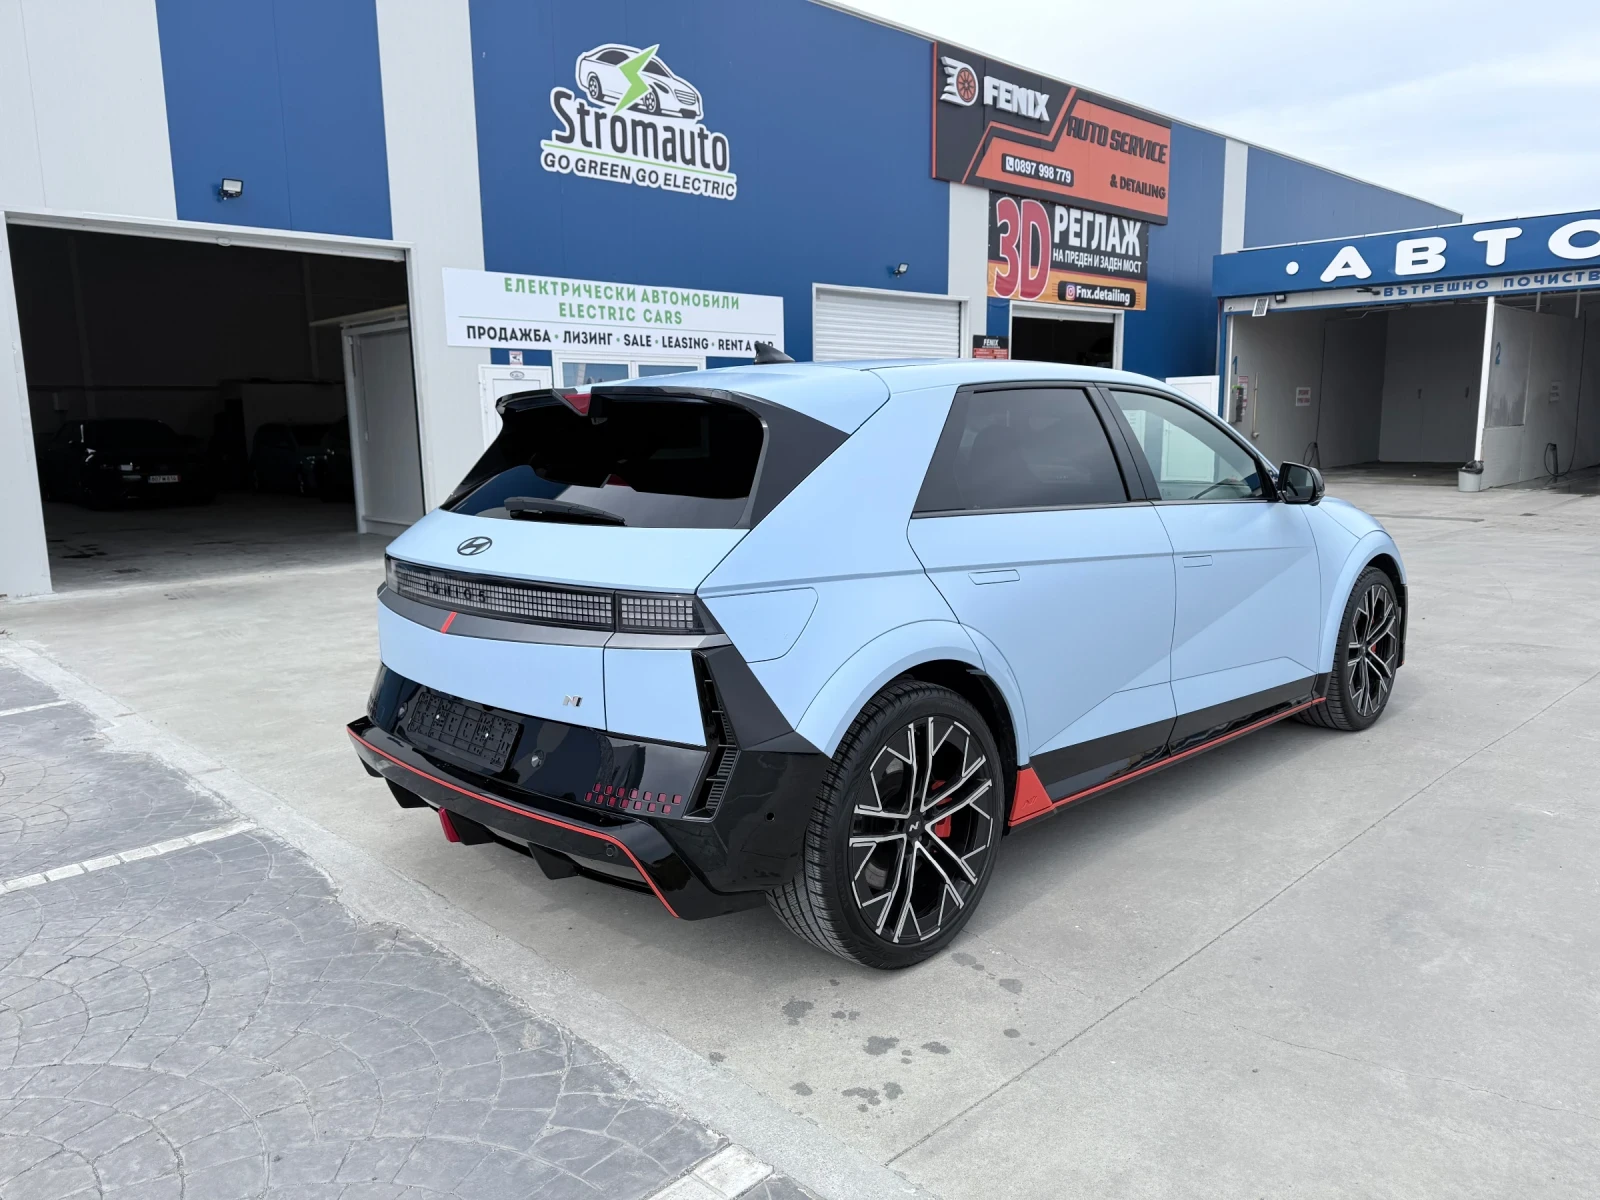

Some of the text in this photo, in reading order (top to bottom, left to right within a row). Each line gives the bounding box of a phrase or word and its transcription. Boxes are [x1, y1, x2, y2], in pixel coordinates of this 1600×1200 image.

[983, 75, 1050, 122] FENIX
[553, 89, 728, 172] Stromauto
[1066, 115, 1168, 164] AUTO SERVICE
[544, 152, 735, 198] GO GREEN GO ELECTRIC
[1014, 157, 1071, 183] 0897 998 779
[1109, 173, 1166, 199] & DETAILING
[1053, 204, 1141, 257] РЕГЛАЖ
[993, 196, 1052, 301] 3D
[1053, 248, 1142, 274] НА ПРЕДЕН И ЗАДЕН МОСТ
[1319, 218, 1600, 283] АВТО
[504, 277, 739, 310] ЕЛЕКТРИЧЕСКИ АВТОМОБИЛИ
[1076, 285, 1131, 306] Fnx.detailing
[1383, 270, 1600, 297] ВЪТРЕШНО ПОЧИСТВ
[559, 302, 682, 325] ELECTRIC CARS
[466, 325, 551, 343] ПРОДАЖБА
[563, 330, 613, 346] ЛИЗИНГ
[623, 333, 652, 347] SALE
[662, 335, 709, 350] LEASING
[718, 338, 743, 351] RENT
[744, 339, 752, 351] A
[1232, 355, 1239, 375] 1
[1495, 342, 1502, 365] 2
